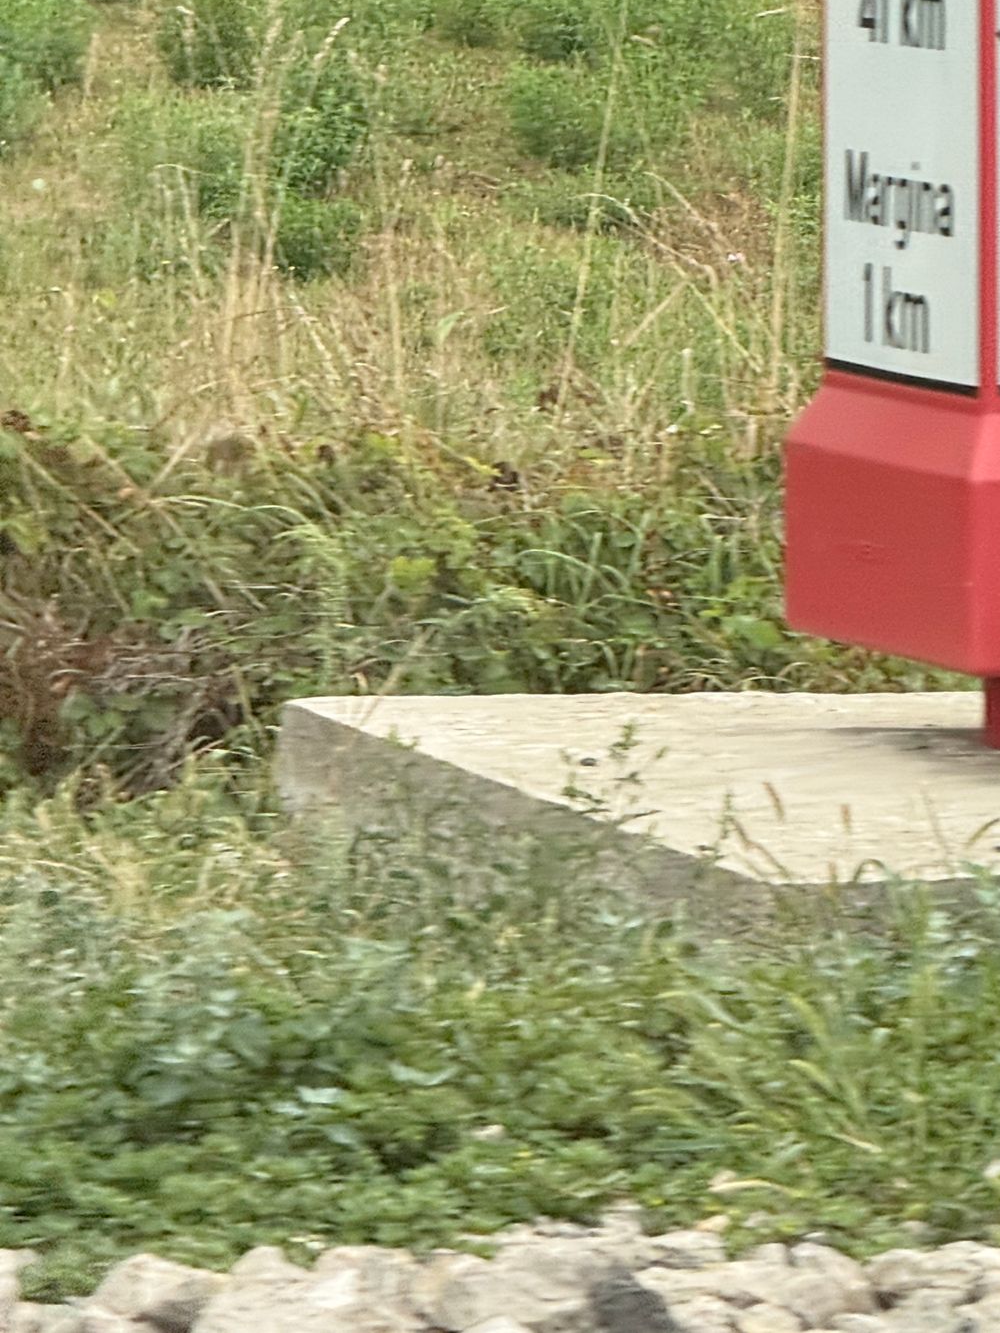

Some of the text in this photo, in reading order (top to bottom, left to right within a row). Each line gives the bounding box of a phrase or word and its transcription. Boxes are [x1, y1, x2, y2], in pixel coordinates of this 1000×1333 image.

[843, 148, 954, 250] Margina
[863, 262, 930, 354] 1 km
